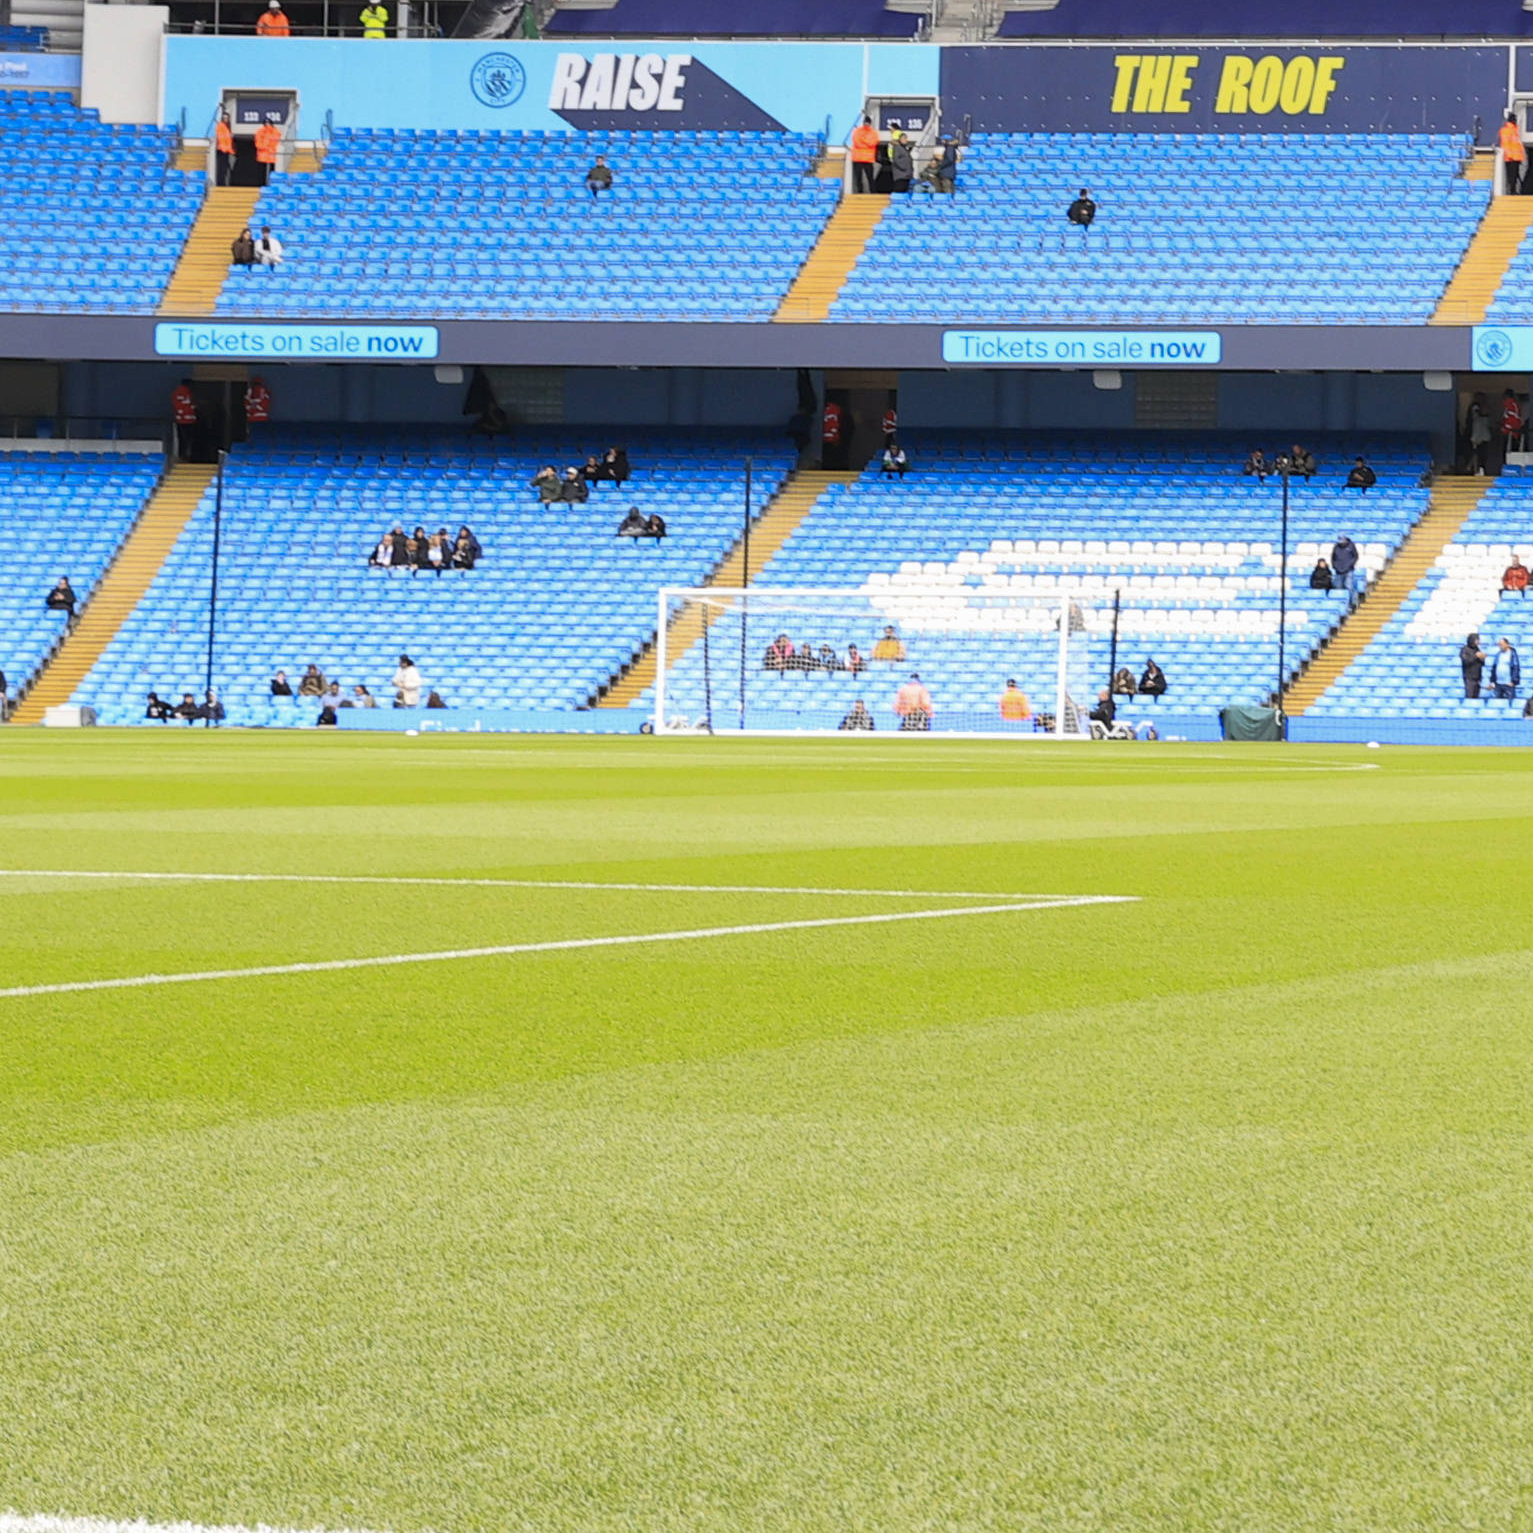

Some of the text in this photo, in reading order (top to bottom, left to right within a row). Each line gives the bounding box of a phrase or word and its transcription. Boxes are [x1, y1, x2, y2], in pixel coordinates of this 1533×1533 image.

[548, 53, 692, 111] RAISE
[1110, 55, 1344, 115] THE ROOF
[172, 328, 424, 353] Tickets on sale now
[959, 335, 1207, 359] Tickets on sale now
